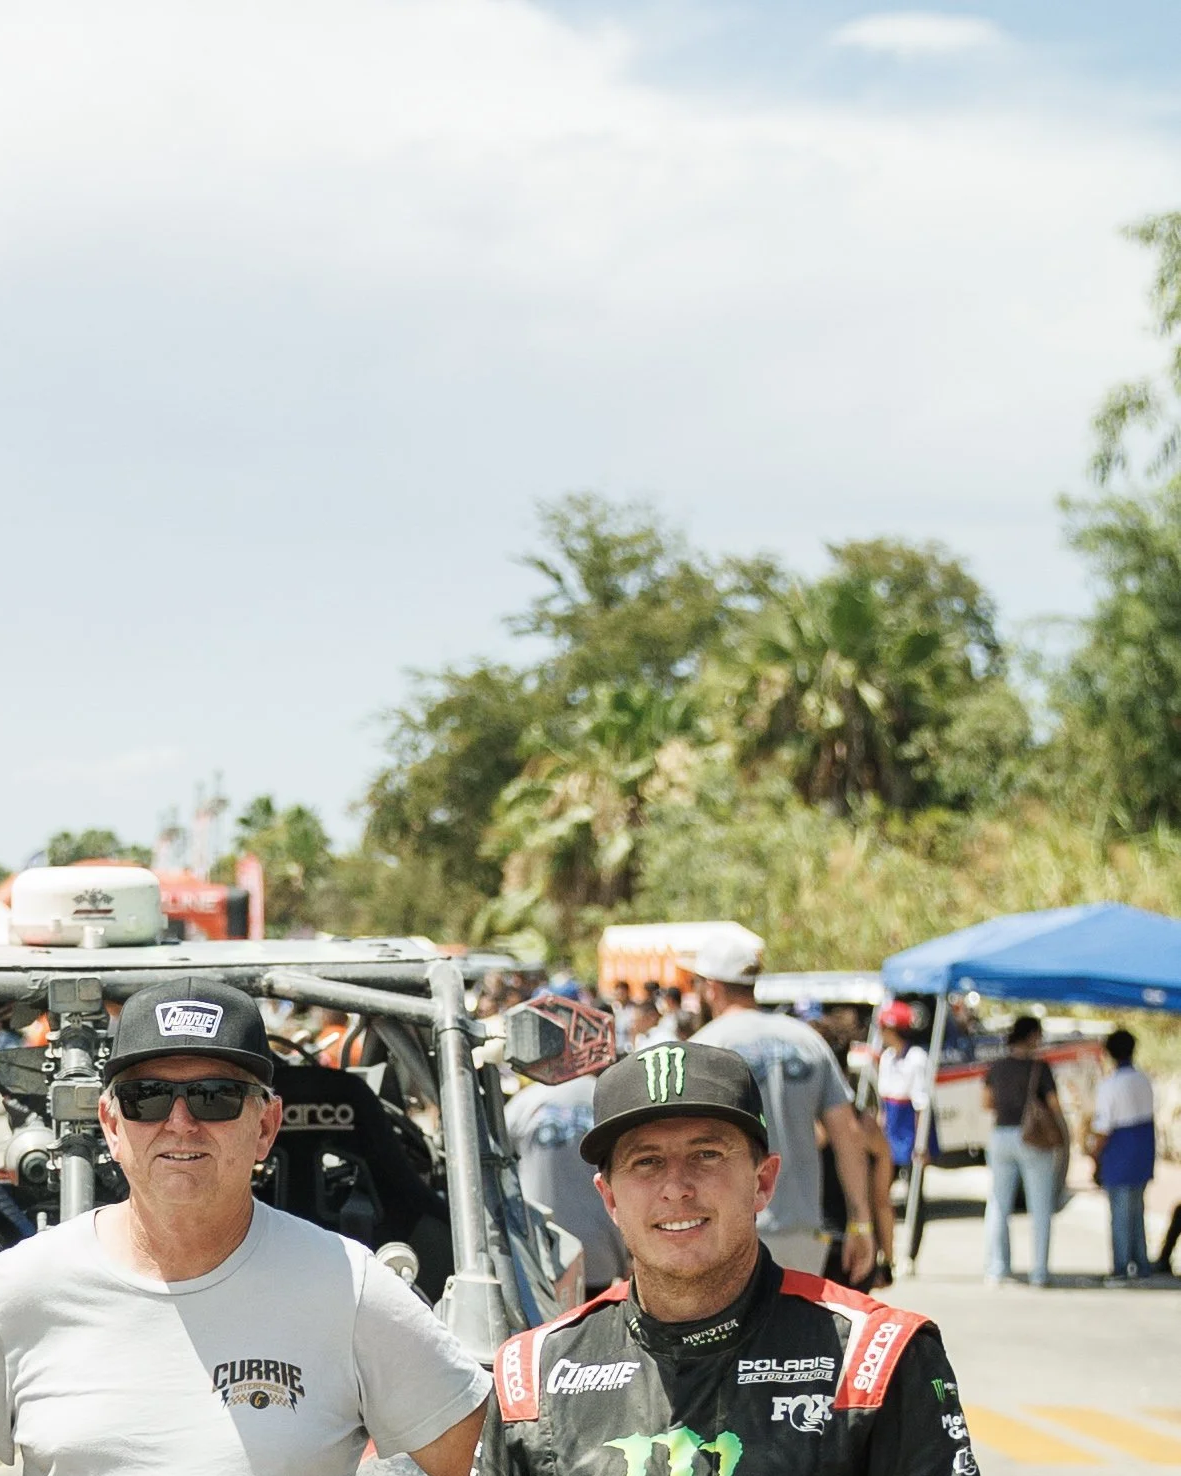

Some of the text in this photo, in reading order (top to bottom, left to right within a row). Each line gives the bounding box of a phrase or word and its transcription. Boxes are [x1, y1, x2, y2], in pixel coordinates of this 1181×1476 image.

[165, 1006, 216, 1029] CURRIE
[283, 1103, 354, 1126] arco
[682, 1318, 739, 1345] MONSTER
[738, 1357, 835, 1372] POLARIS
[853, 1322, 898, 1392] sparco
[213, 1359, 306, 1398] CURRIE
[546, 1358, 641, 1394] CURRIE
[737, 1370, 833, 1383] FACTORY RACING
[771, 1394, 836, 1435] FOX
